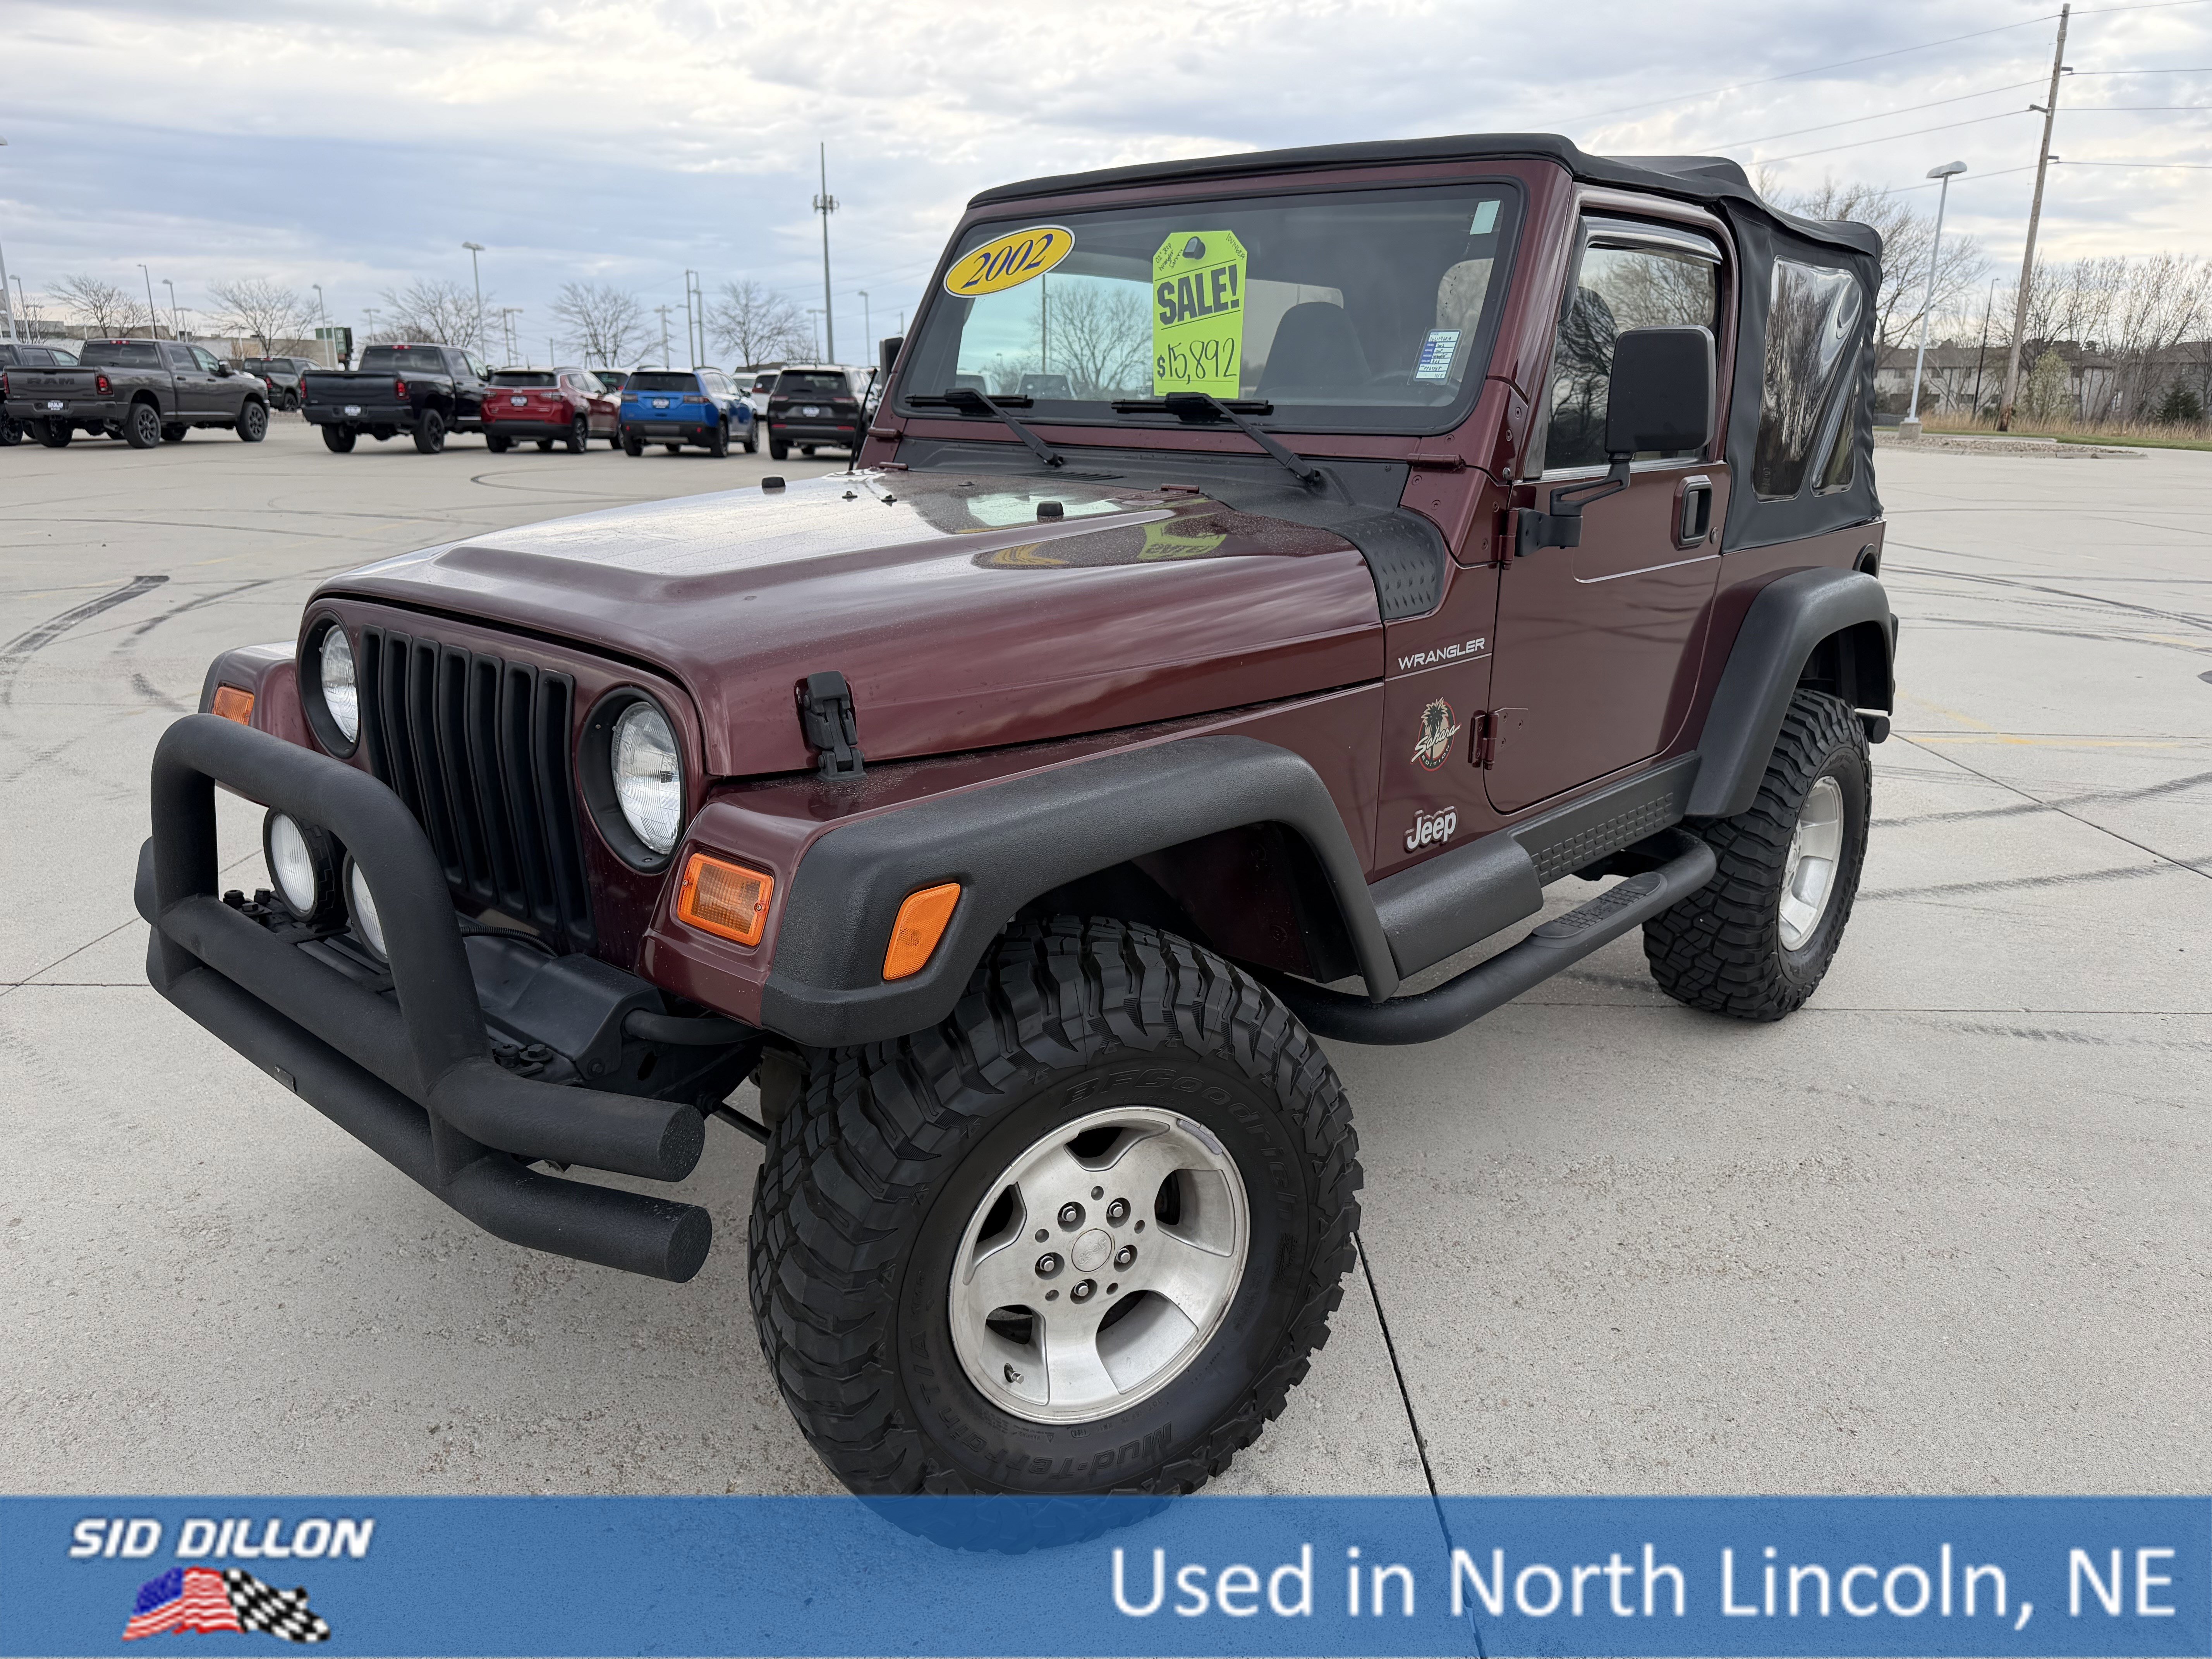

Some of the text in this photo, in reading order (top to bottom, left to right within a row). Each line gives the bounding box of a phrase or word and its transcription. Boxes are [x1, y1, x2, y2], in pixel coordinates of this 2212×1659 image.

[960, 233, 1053, 289] 2002
[1157, 264, 1240, 325] SALE!
[1157, 338, 1237, 385] $15,892
[1397, 637, 1485, 670] WRANGLER
[1411, 724, 1462, 763] Sahara
[1421, 745, 1450, 767] EDITION
[1406, 808, 1458, 850] Jeep
[1059, 1067, 1298, 1221] BFGoodrich
